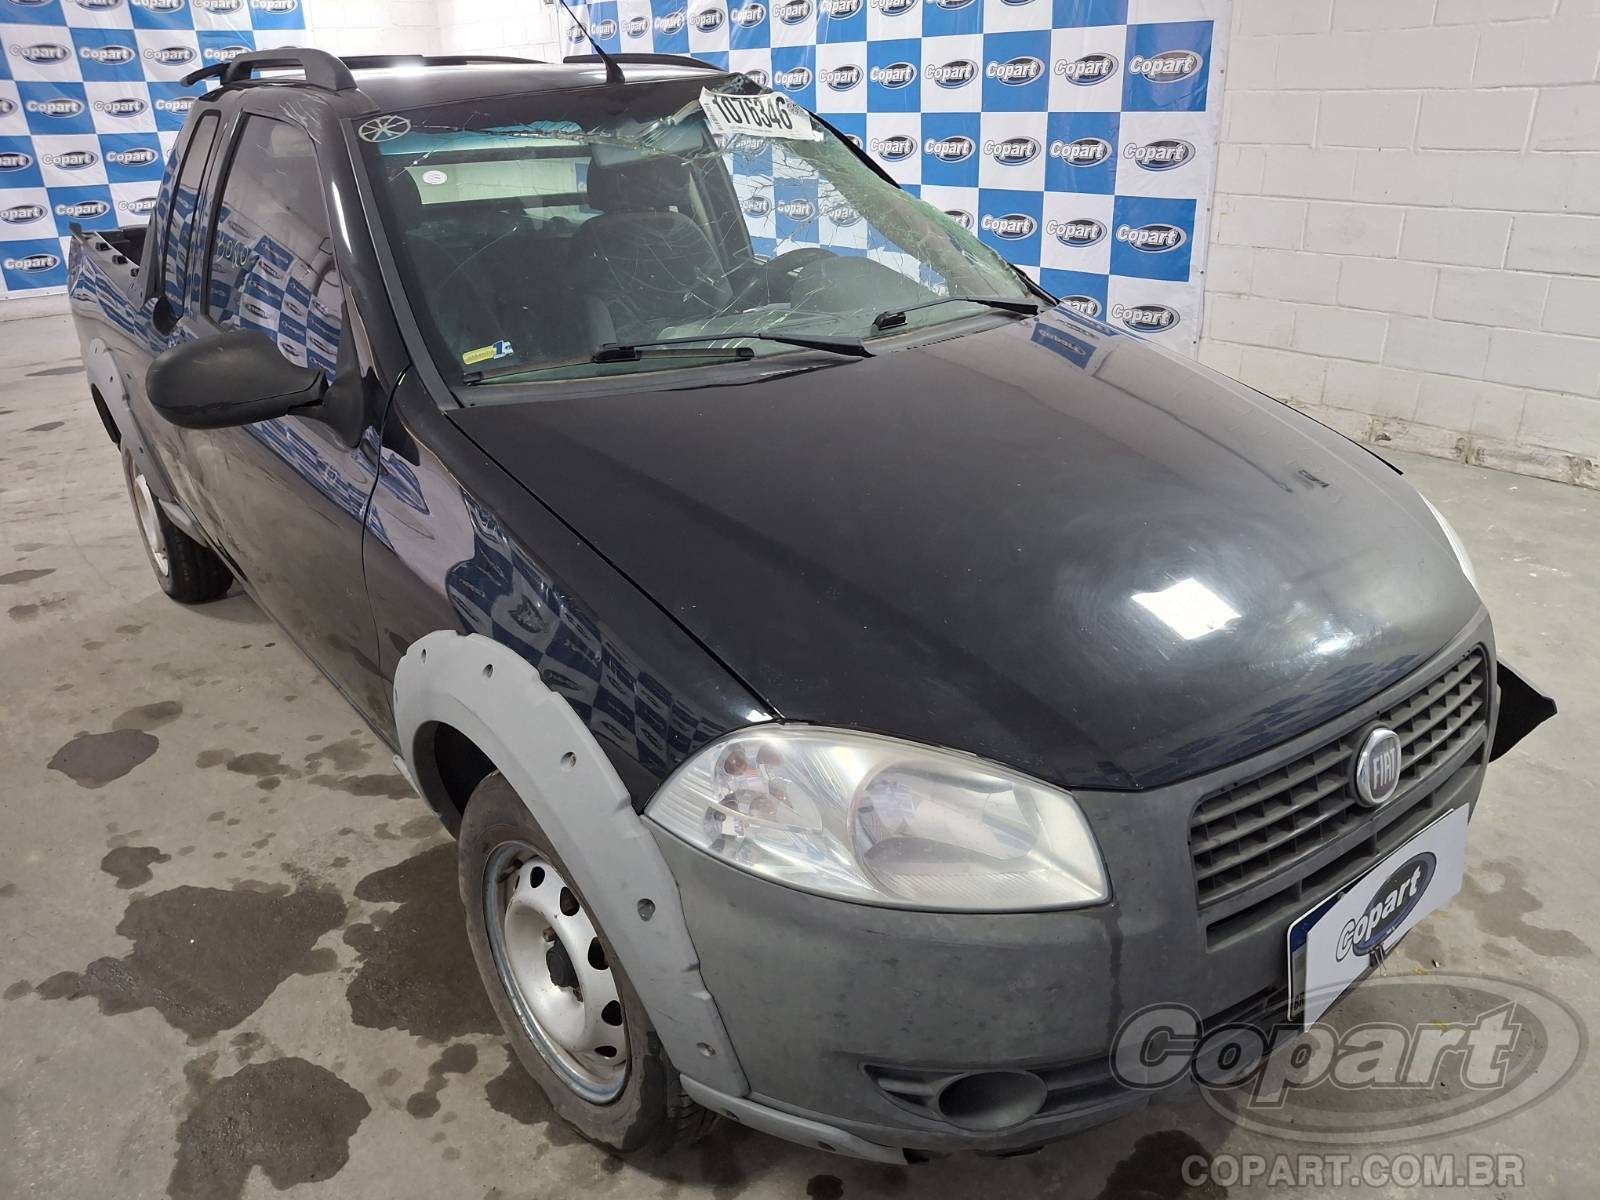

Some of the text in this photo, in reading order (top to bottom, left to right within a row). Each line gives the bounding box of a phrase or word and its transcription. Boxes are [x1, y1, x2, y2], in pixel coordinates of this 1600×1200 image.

[688, 12, 720, 28] Copart
[731, 7, 762, 25] Copart
[772, 3, 810, 22] Copart
[591, 23, 613, 36] Copart
[622, 20, 646, 36] Copart
[9, 44, 65, 60] Copart
[80, 46, 129, 61] Copart
[144, 47, 192, 61] Copart
[986, 61, 1038, 83] Copart
[1054, 57, 1112, 78] Copart
[1129, 53, 1195, 76] Copart
[774, 70, 810, 88] Copart
[819, 69, 859, 83] Copart
[869, 65, 914, 84] Copart
[924, 64, 972, 84] Copart
[26, 101, 78, 116] Copart
[94, 101, 140, 114] Copart
[712, 95, 792, 130] 1076346
[869, 138, 912, 155] Copart
[923, 138, 971, 156] Copart
[983, 139, 1034, 158] Copart
[1050, 140, 1108, 160] Copart
[1123, 142, 1185, 162] Copart
[42, 153, 91, 167] Copart
[105, 150, 154, 167] Copart
[0, 206, 41, 223] opart
[55, 204, 103, 218] Copart
[980, 213, 1034, 234] Copart
[1046, 219, 1103, 239] Copart
[1115, 223, 1178, 246] Copart
[3, 256, 54, 272] Copart
[1111, 303, 1172, 326] Copart
[1372, 747, 1396, 791] FIAT
[1335, 863, 1422, 963] Copart
